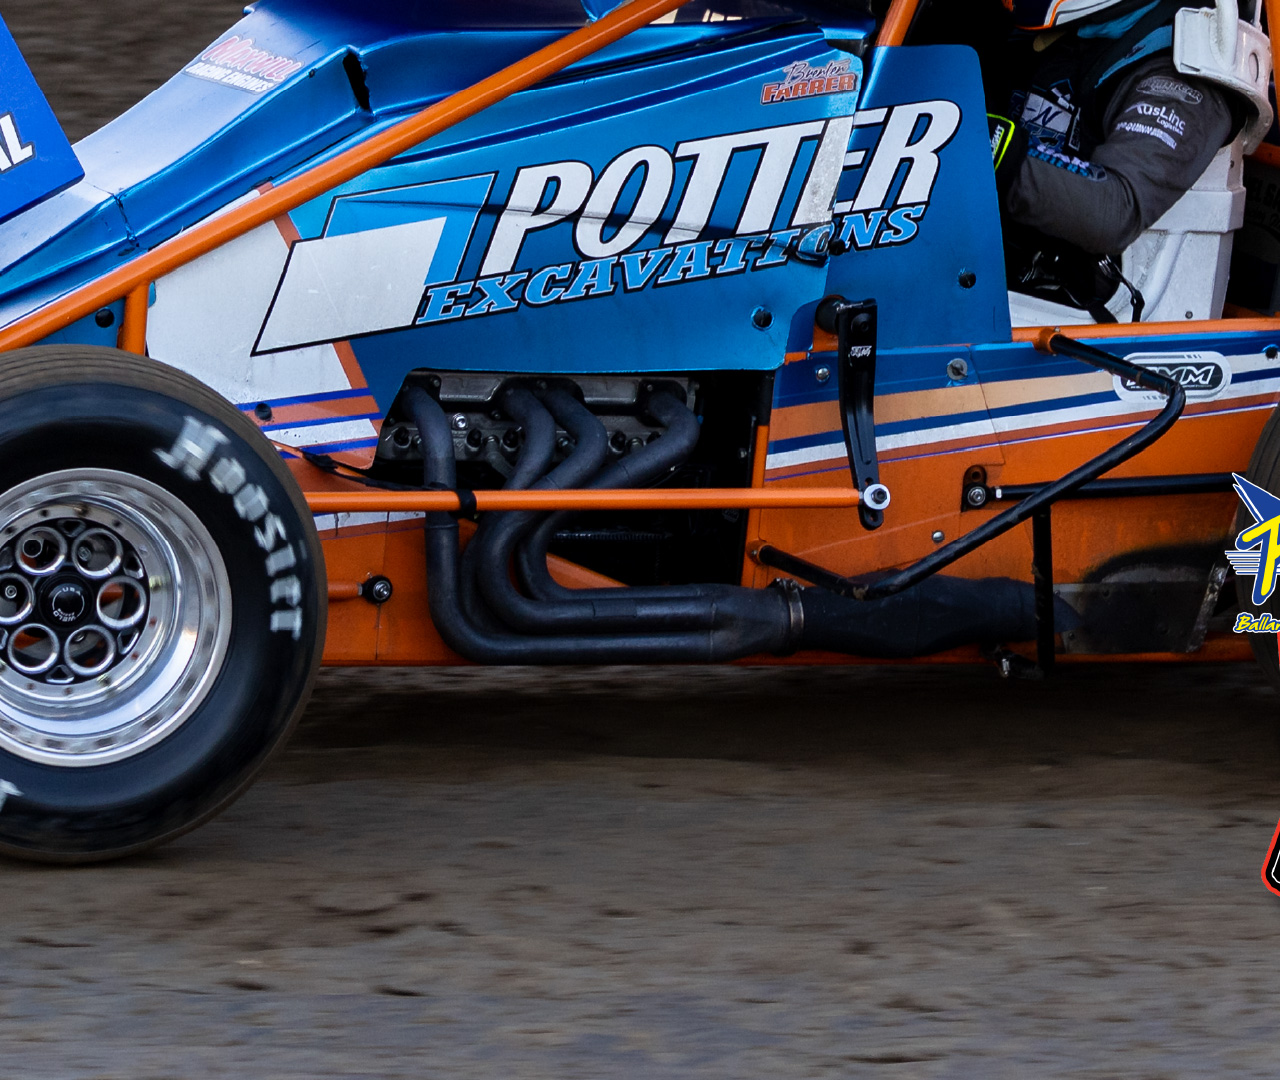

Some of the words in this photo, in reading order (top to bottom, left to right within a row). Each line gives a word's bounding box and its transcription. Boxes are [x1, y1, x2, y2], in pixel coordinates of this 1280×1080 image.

[762, 73, 857, 104] FARRER
[478, 99, 963, 280] POTTER
[416, 201, 927, 327] EXCAVATIONS
